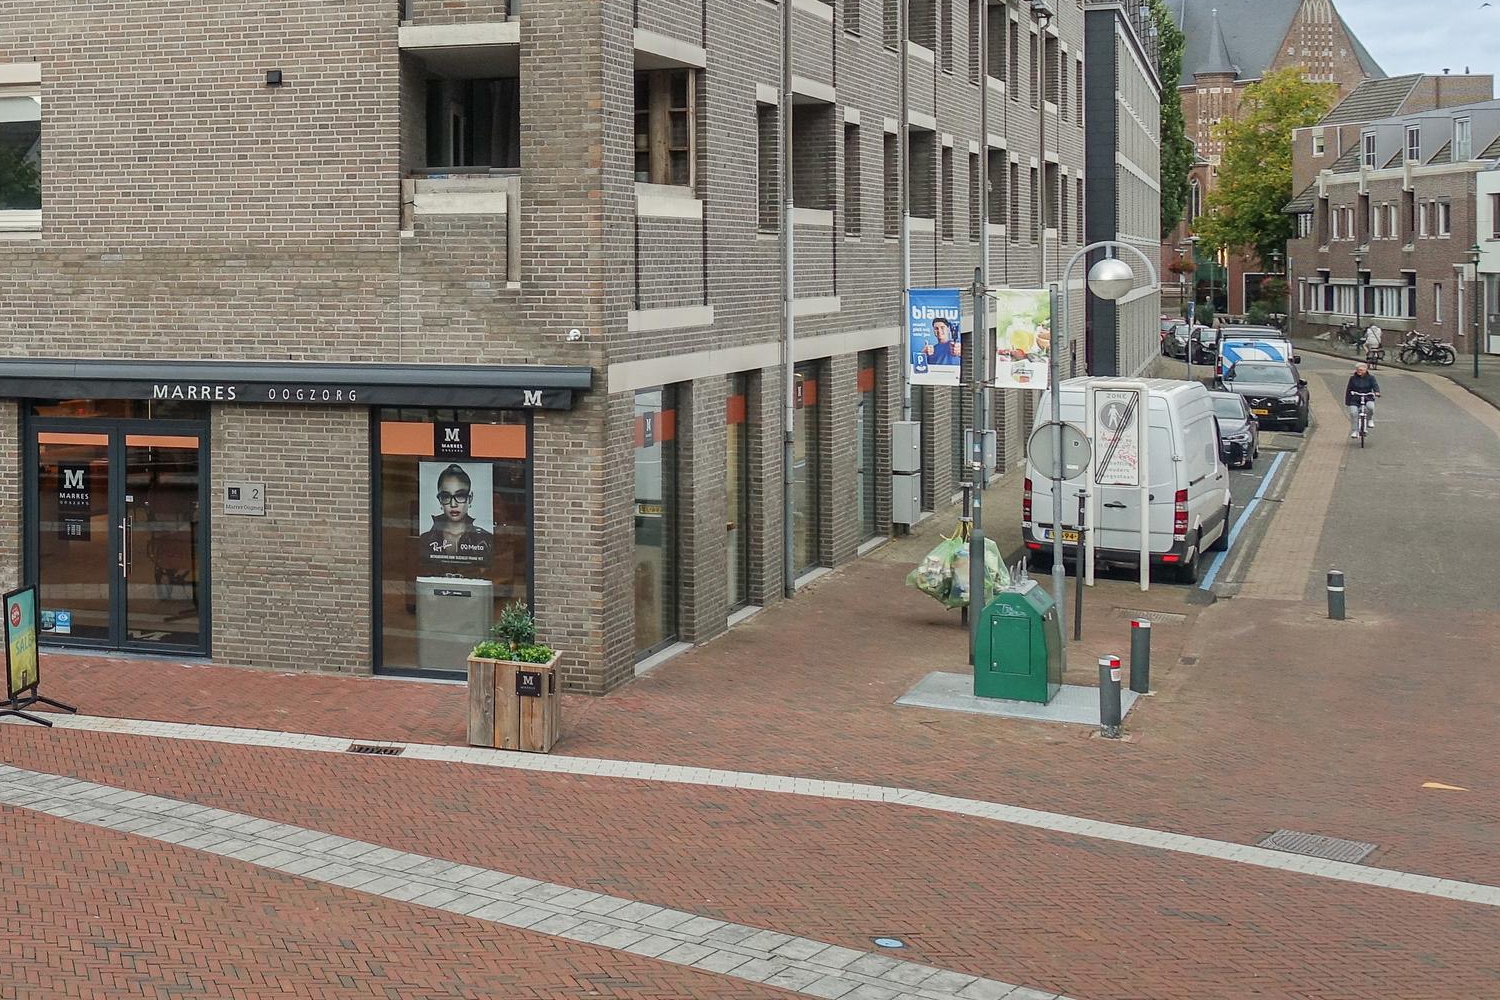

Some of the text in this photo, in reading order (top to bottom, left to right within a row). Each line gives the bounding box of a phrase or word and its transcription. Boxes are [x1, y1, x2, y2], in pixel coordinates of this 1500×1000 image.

[912, 306, 958, 320] blauw
[153, 384, 357, 402] MARRES OOGZORG
[524, 390, 542, 406] M
[444, 428, 460, 442] M
[64, 469, 84, 489] M
[252, 489, 258, 499] 2
[523, 675, 534, 686] M
